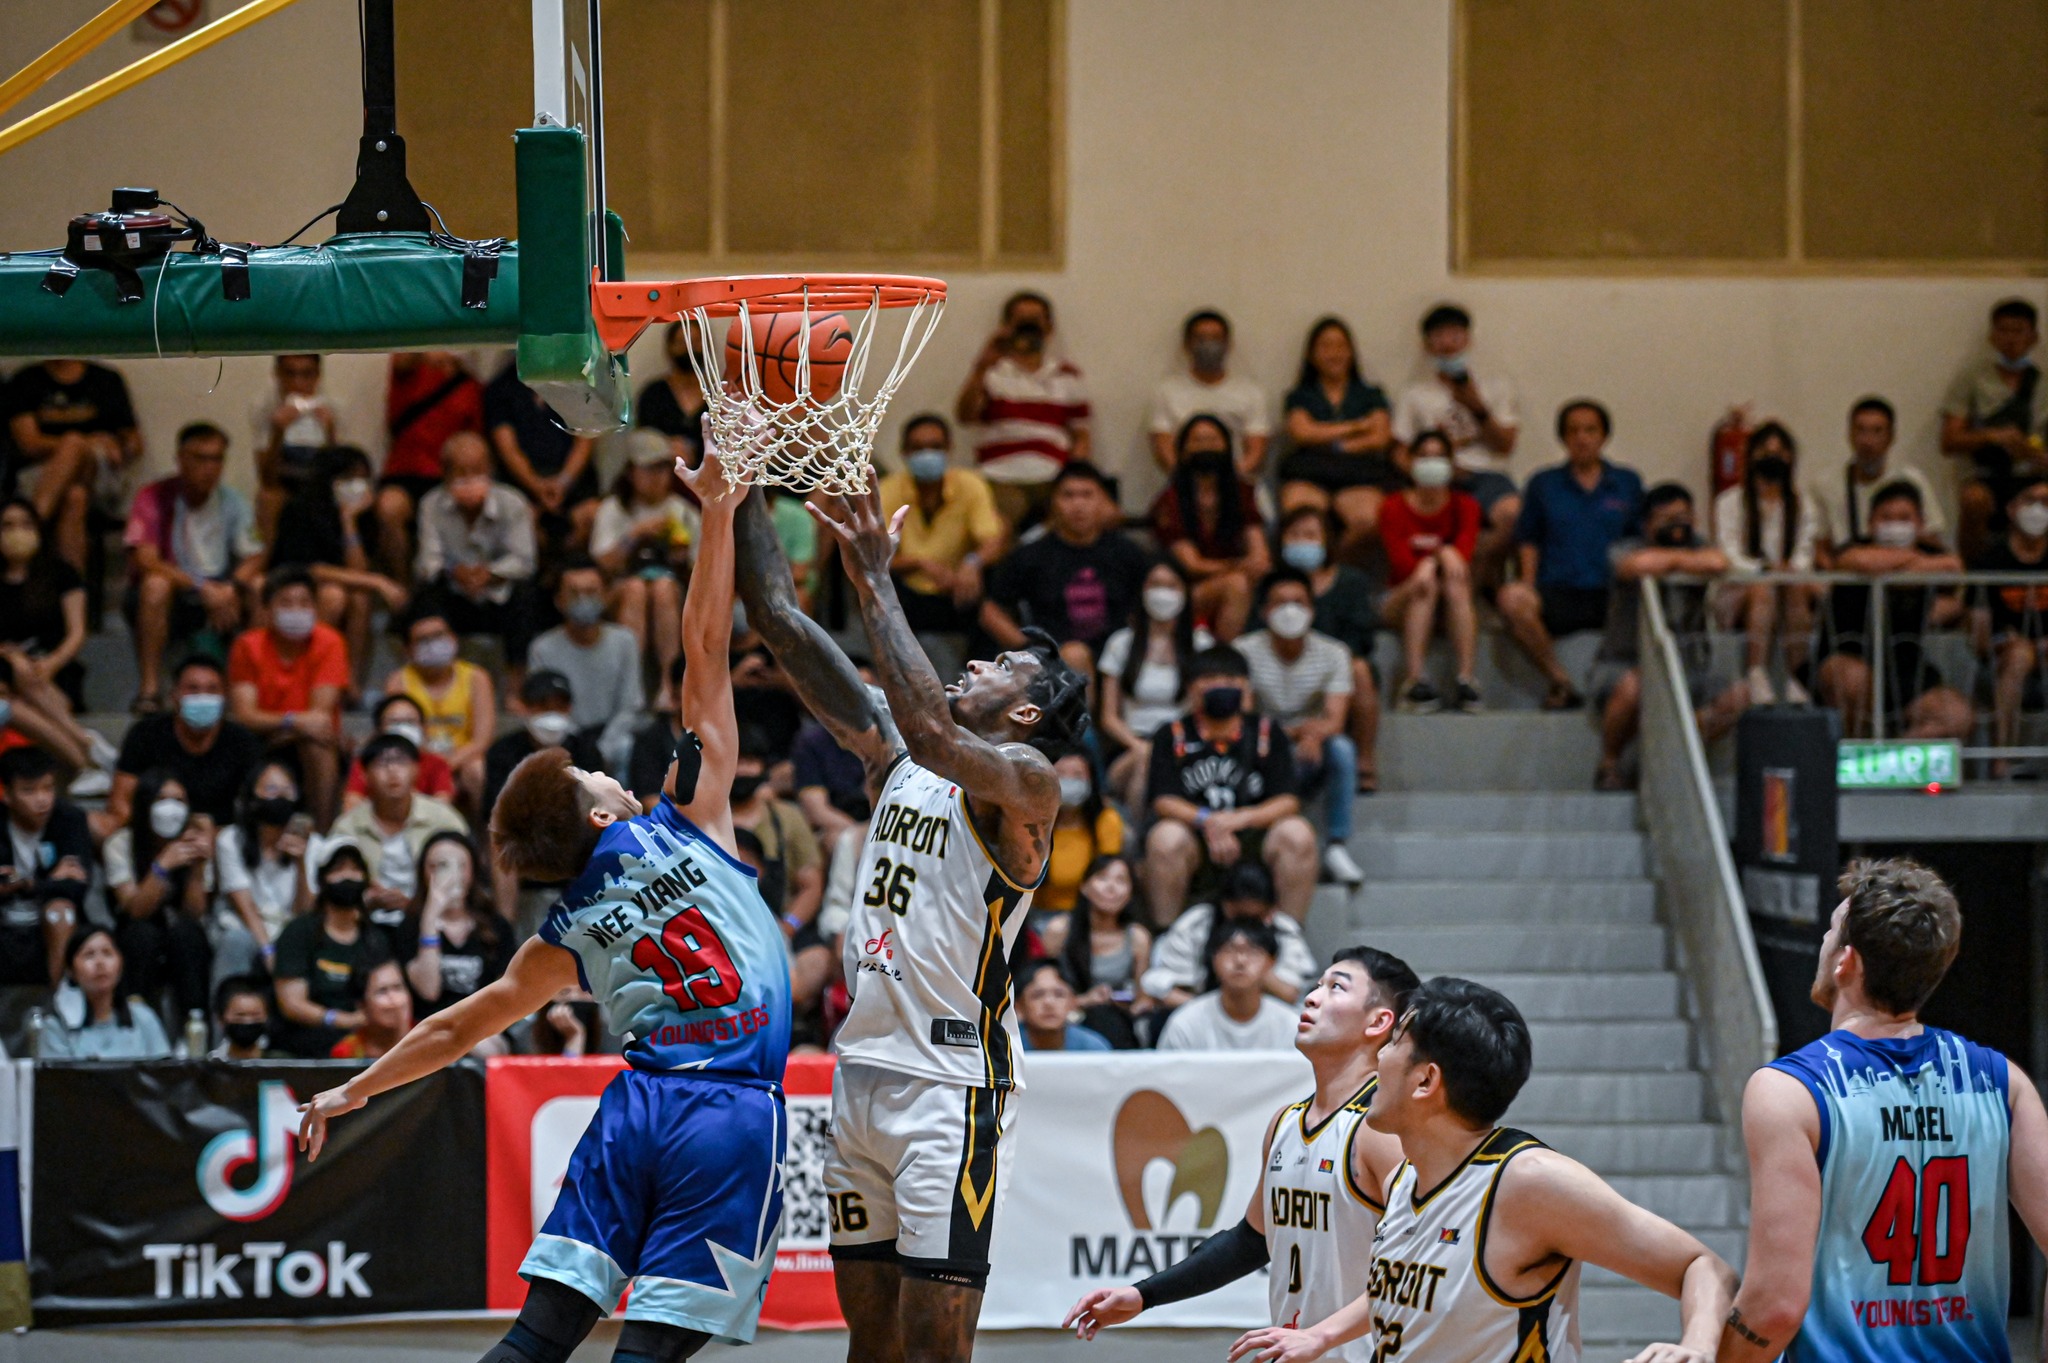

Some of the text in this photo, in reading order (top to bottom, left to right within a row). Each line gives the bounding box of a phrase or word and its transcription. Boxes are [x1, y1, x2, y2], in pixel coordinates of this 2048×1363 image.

[583, 857, 708, 949] WEE YIANG
[864, 857, 916, 916] 36
[631, 904, 743, 1012] 19
[1861, 1155, 1971, 1286] 40
[143, 1241, 373, 1298] TikTok
